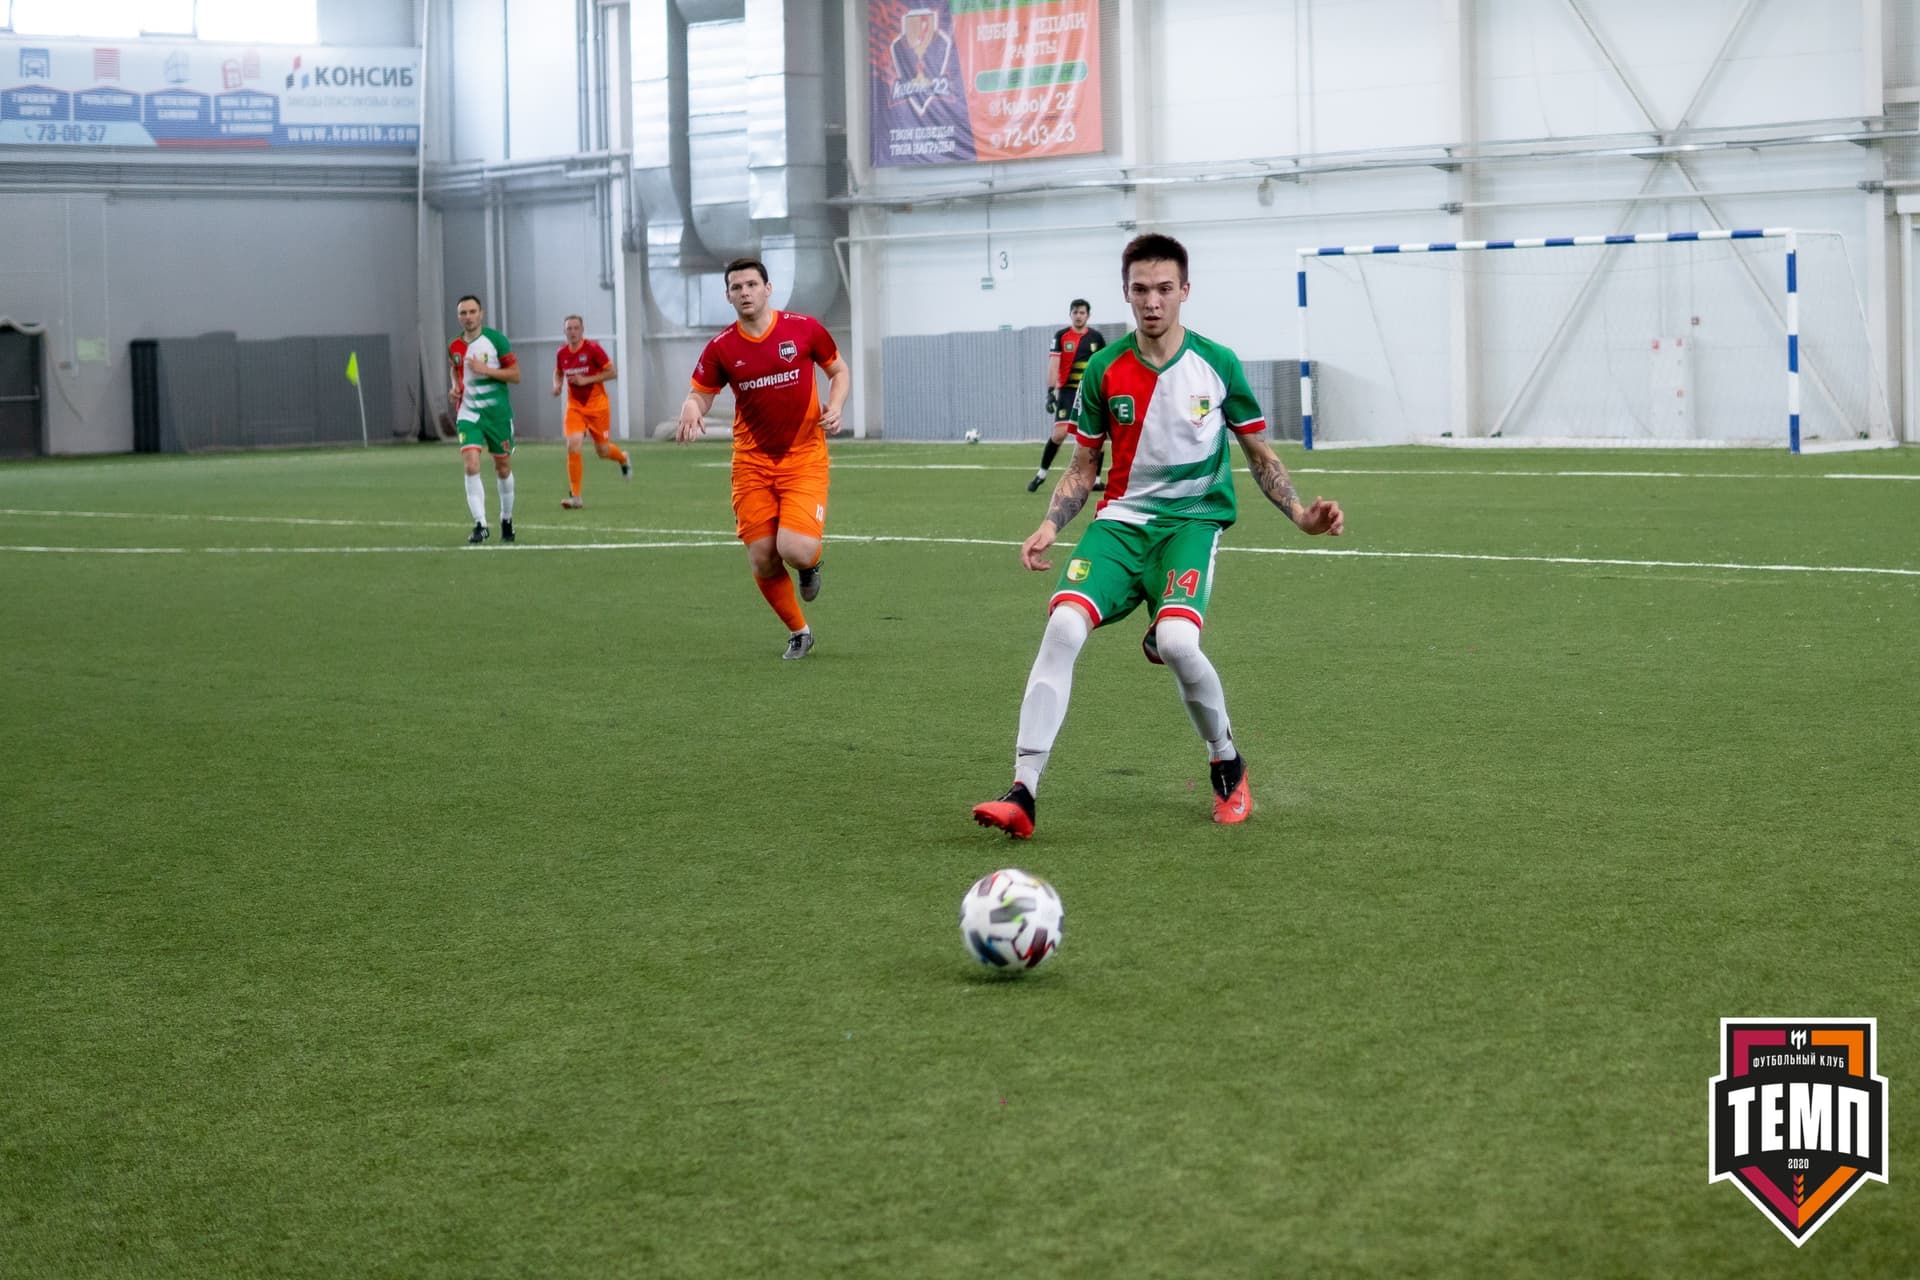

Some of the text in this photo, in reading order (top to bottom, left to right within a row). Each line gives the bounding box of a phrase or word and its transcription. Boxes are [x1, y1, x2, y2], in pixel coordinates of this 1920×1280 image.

[315, 66, 414, 87] КОНСИБ
[1003, 122, 1076, 148] 72-03-23
[999, 250, 1009, 270] 3
[738, 368, 801, 392] ПРОДИНВЕСТ
[1163, 568, 1201, 599] 14
